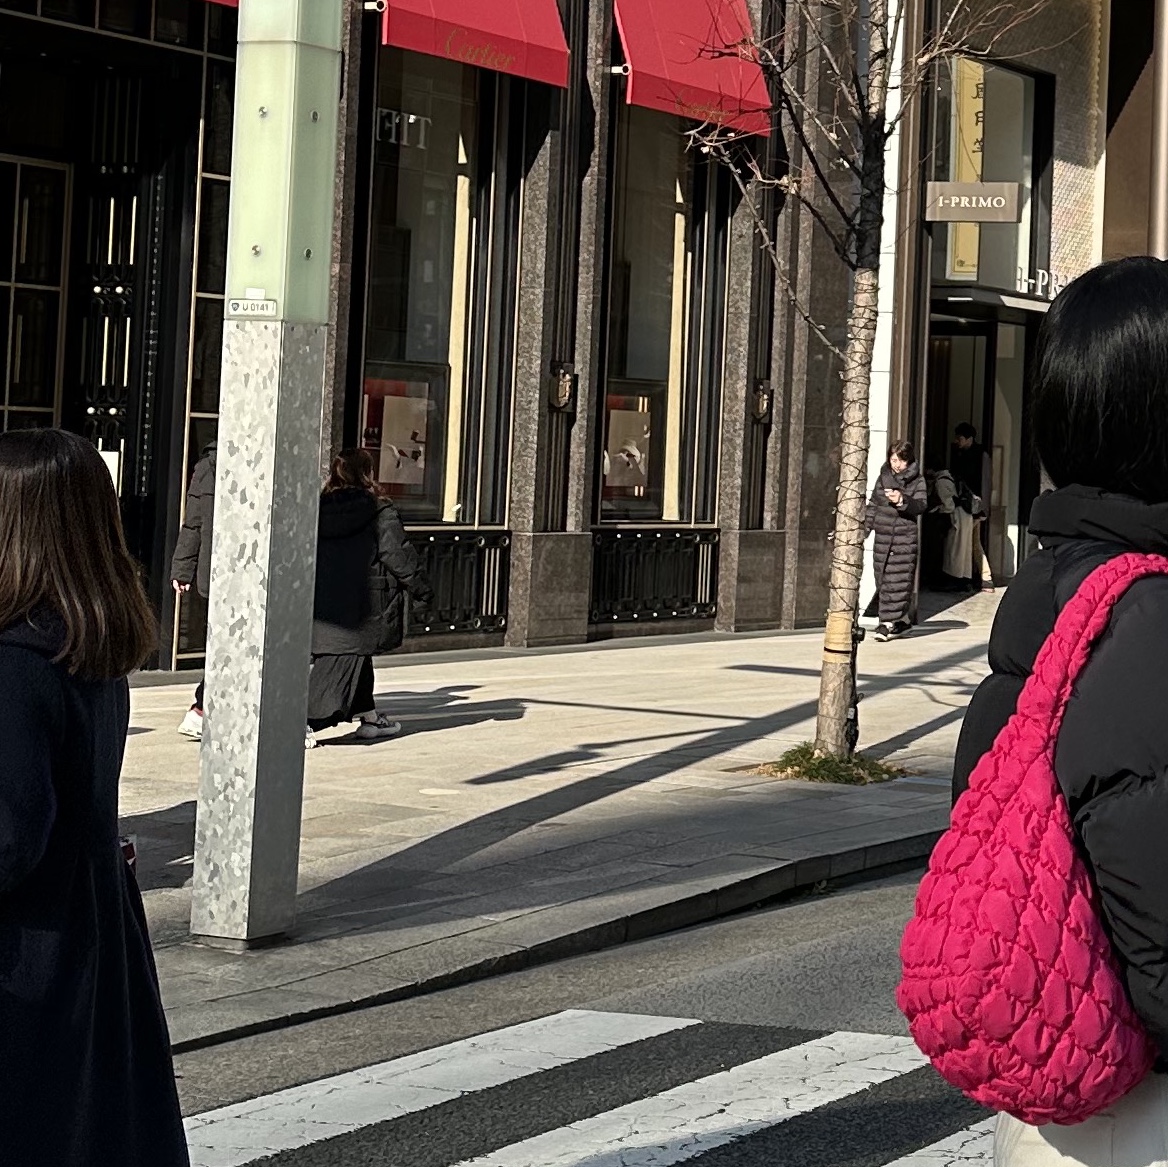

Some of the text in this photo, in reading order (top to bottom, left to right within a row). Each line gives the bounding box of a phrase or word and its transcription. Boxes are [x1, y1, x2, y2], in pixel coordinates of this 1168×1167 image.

[444, 28, 517, 70] Cartier
[938, 196, 1006, 209] I-PRIMO
[250, 303, 269, 312] 0141
